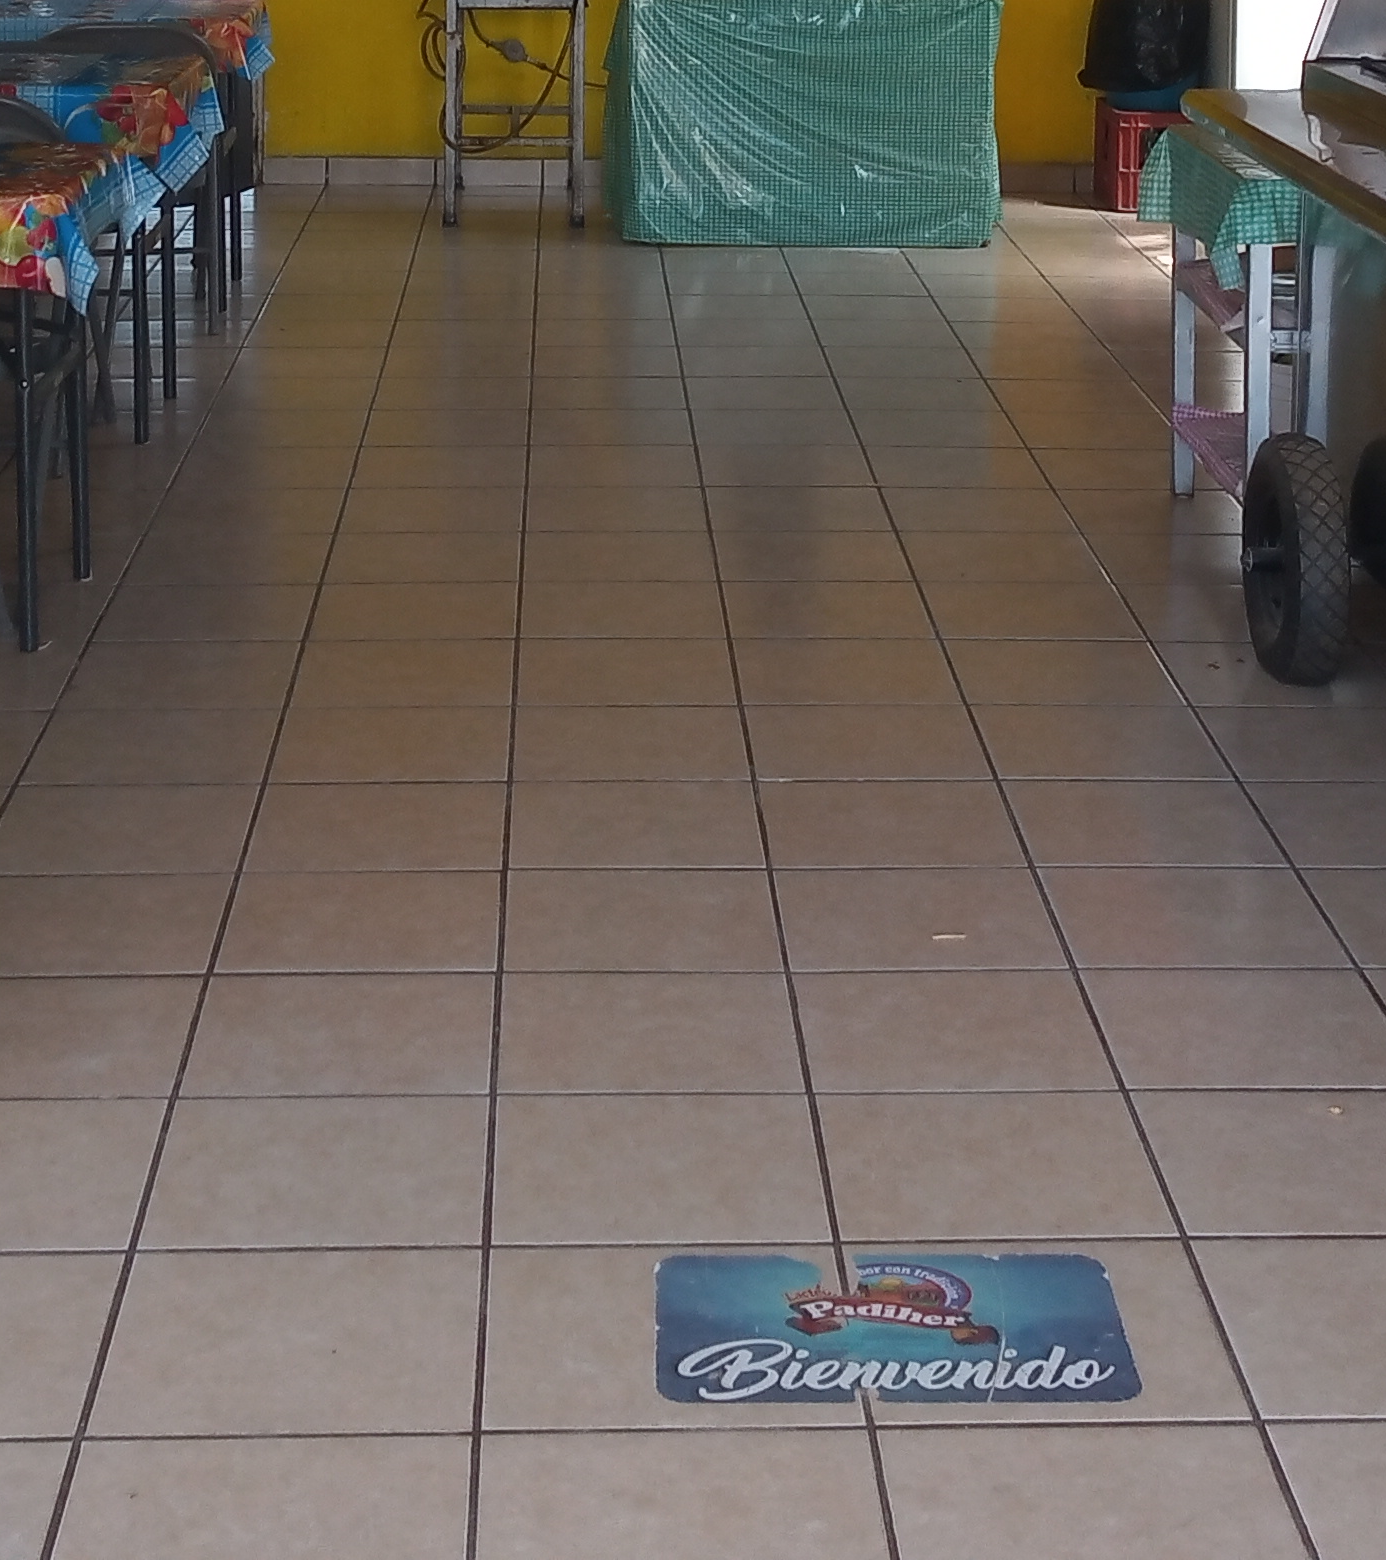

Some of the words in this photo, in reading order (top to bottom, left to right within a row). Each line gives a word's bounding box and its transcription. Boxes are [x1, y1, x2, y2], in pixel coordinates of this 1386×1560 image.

[884, 1265, 911, 1275] con
[800, 1300, 965, 1328] Padiher
[677, 1337, 1116, 1402] Bienvenido
